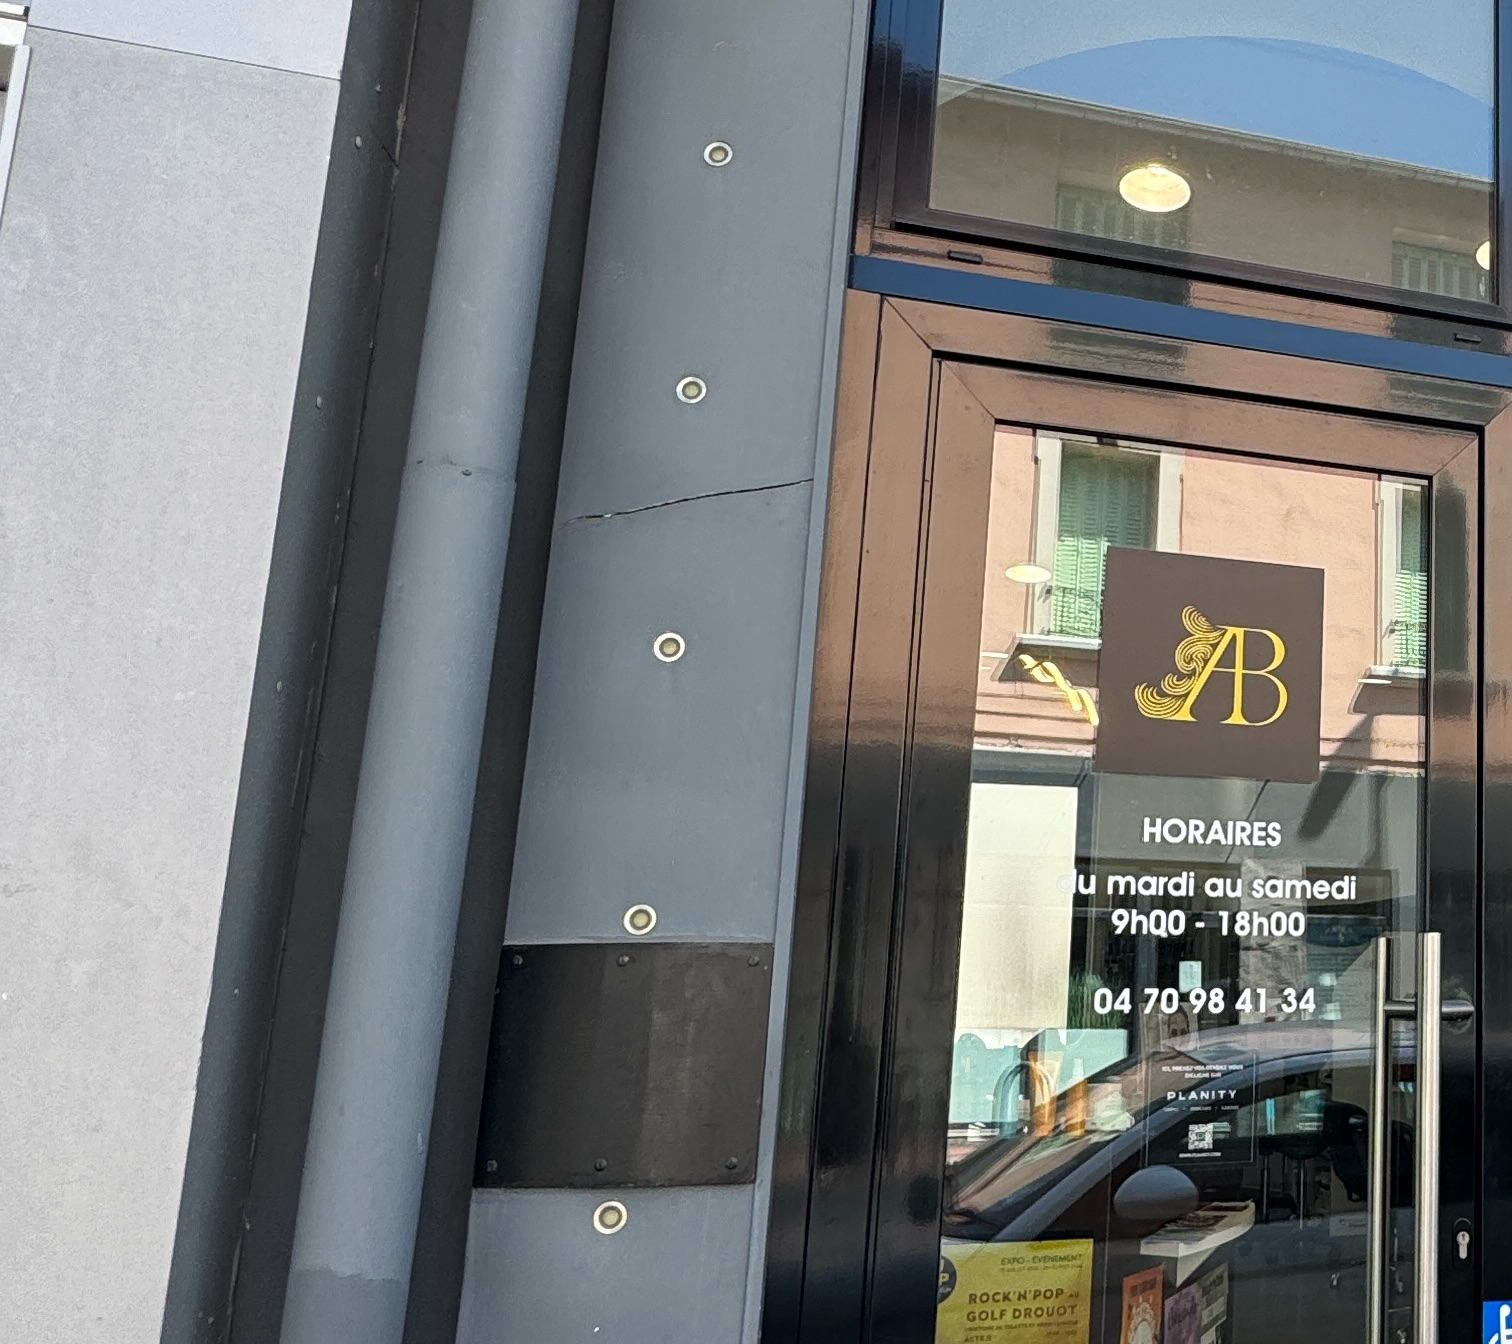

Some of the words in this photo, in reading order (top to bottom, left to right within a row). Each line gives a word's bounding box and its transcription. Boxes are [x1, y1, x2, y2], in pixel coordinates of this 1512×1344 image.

[1142, 816, 1282, 847] HORAIRES
[1107, 871, 1195, 897] mardi
[1204, 878, 1242, 898] au
[1251, 875, 1357, 900] samedi
[1111, 909, 1186, 937] 9h00
[1218, 910, 1306, 937] 18h00
[1093, 988, 1132, 1014] 04
[1143, 987, 1180, 1014] 70
[1189, 987, 1225, 1014] 98
[1235, 987, 1267, 1013] 41
[1281, 987, 1316, 1014] 34
[1166, 1089, 1237, 1101] PLANITY
[968, 1287, 1064, 1306] ROCK'N'POP
[966, 1308, 1007, 1323] GOLF
[1012, 1303, 1078, 1320] DROUOT
